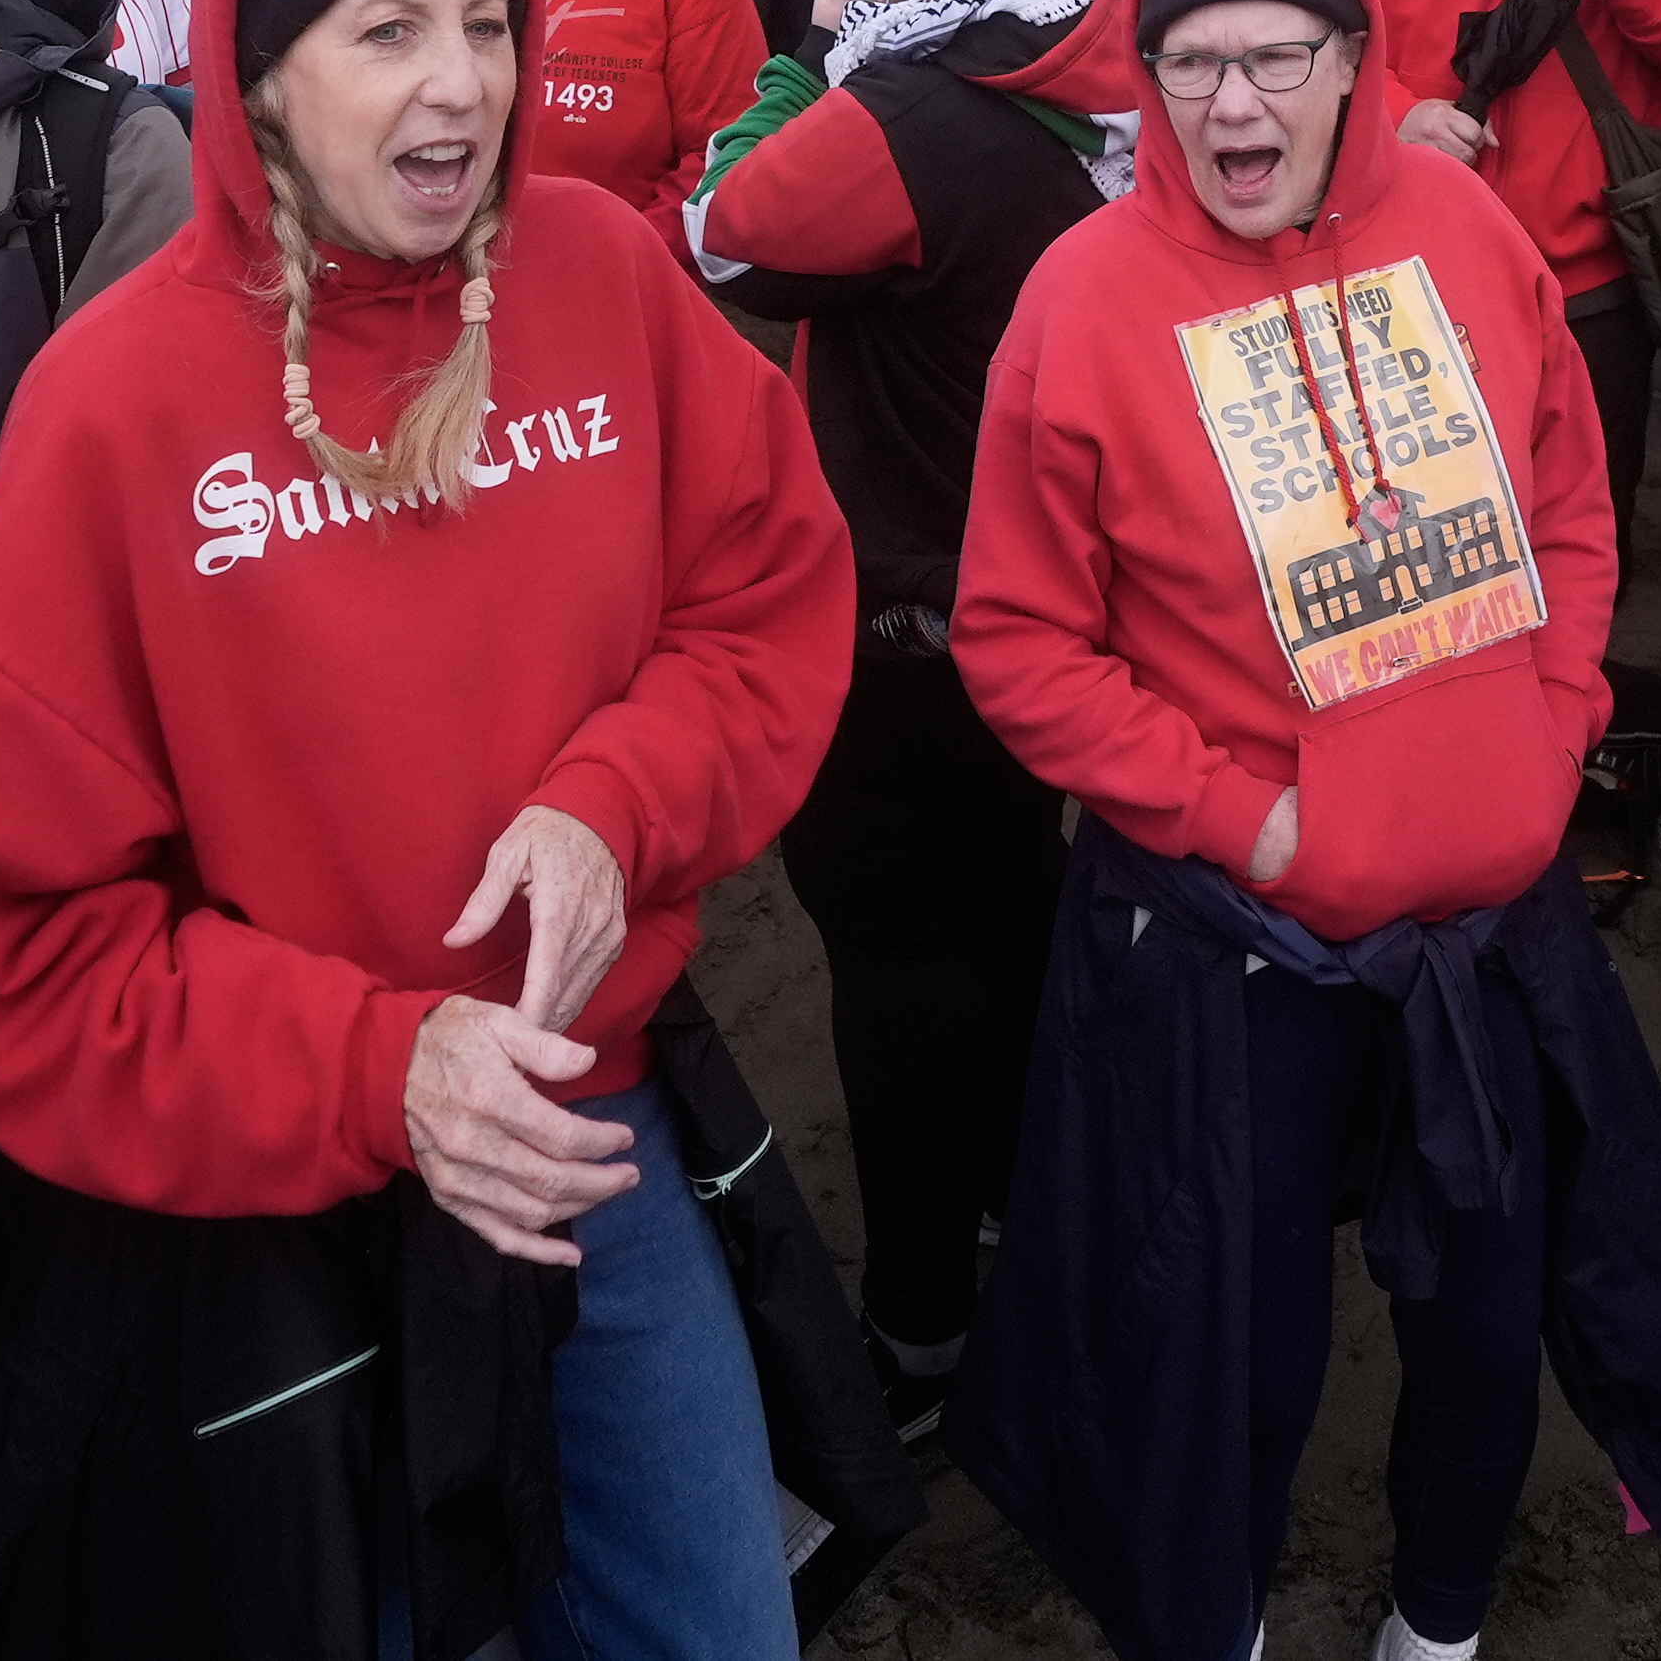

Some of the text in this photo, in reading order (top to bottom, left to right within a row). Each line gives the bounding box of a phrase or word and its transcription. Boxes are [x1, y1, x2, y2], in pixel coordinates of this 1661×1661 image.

[544, 52, 644, 70] MMUNITY COLLEGE
[571, 69, 627, 83] TEACHERS
[544, 80, 614, 112] 1493
[1345, 286, 1394, 325] NEED
[1244, 315, 1392, 391] FULLY
[1250, 384, 1439, 472] STABLE
[1249, 412, 1477, 514] SCHOOLS
[1305, 583, 1528, 703] WE CAN'T WAIT!
